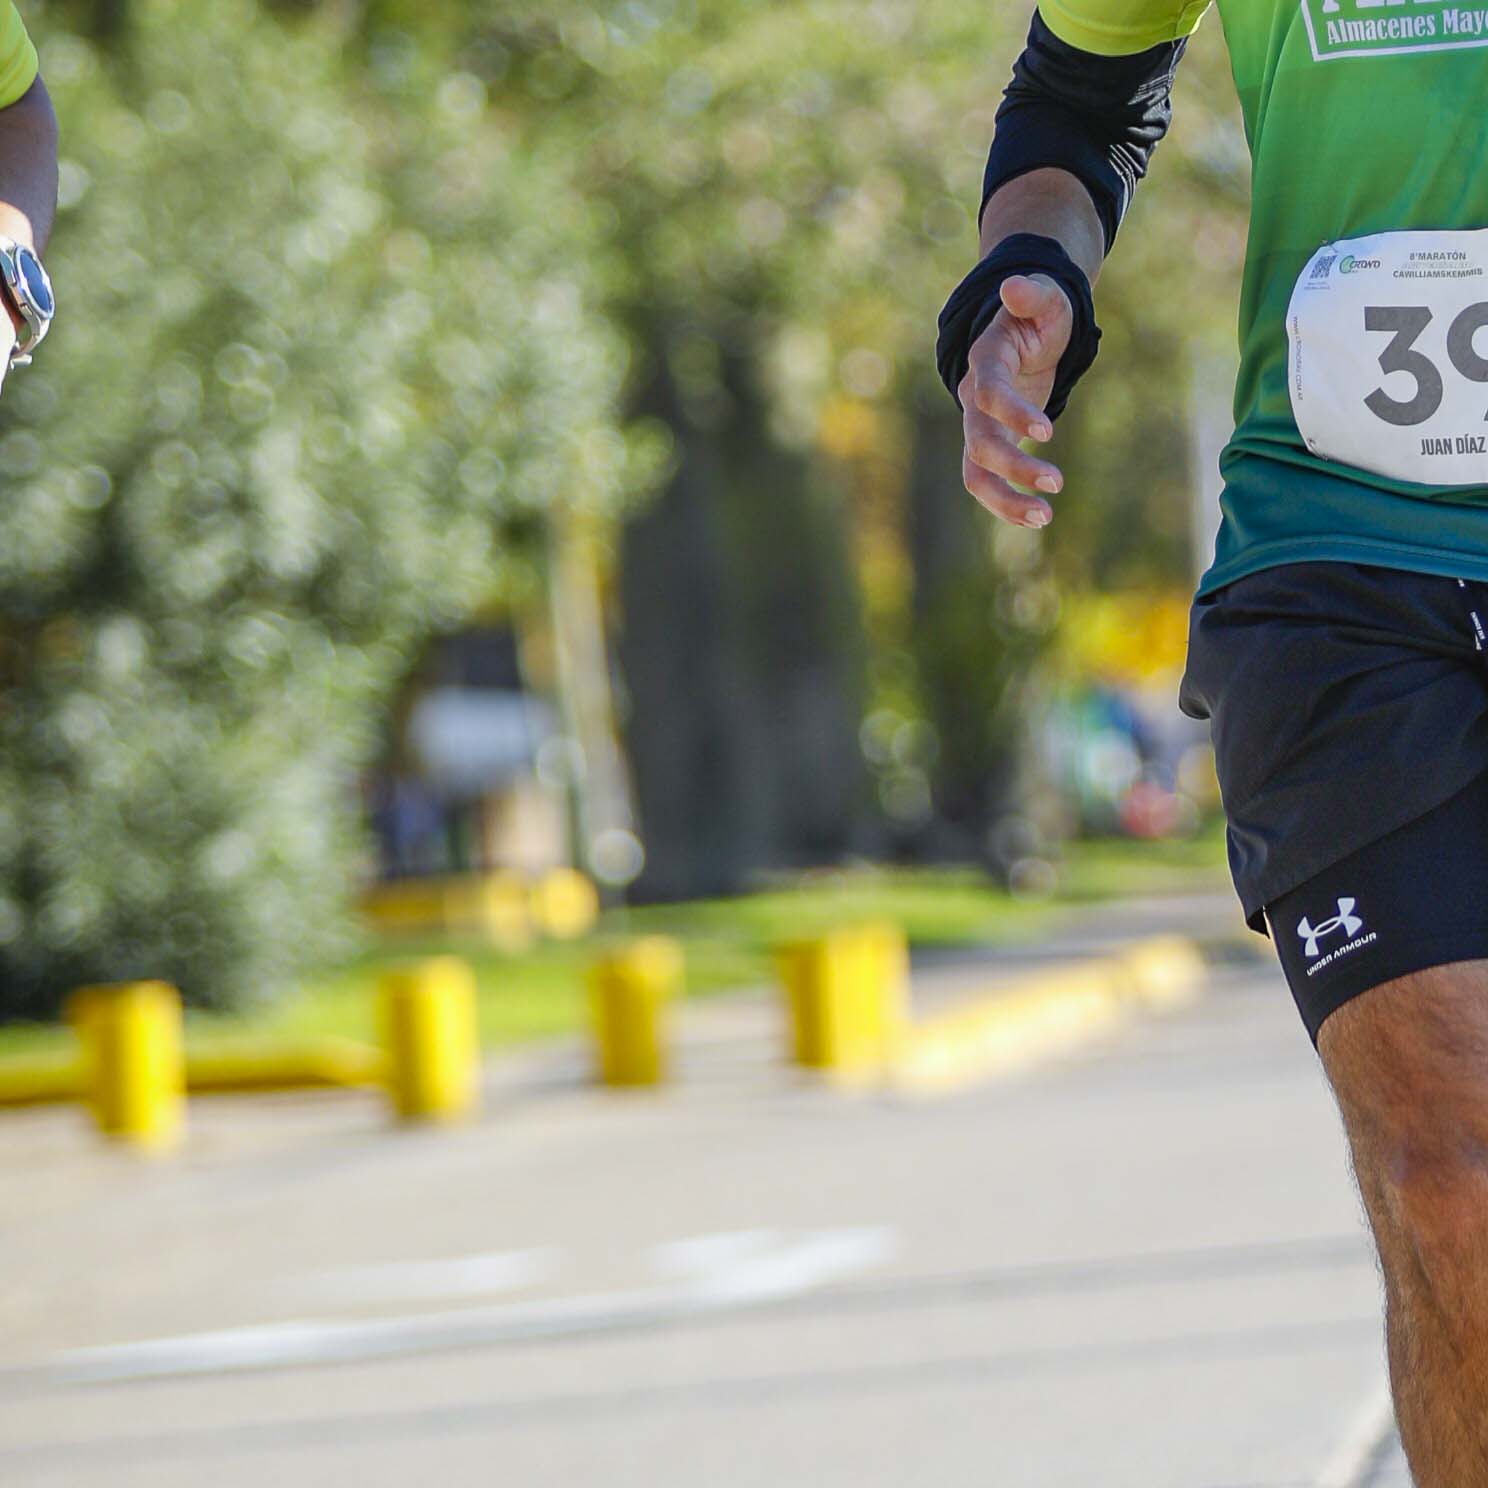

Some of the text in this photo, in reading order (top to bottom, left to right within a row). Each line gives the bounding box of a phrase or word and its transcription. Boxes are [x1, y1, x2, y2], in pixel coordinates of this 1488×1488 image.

[1325, 12, 1436, 45] Almacenes
[1420, 433, 1487, 456] JUAN DÍAZ
[1306, 932, 1377, 976] UNDER ARMOUR
